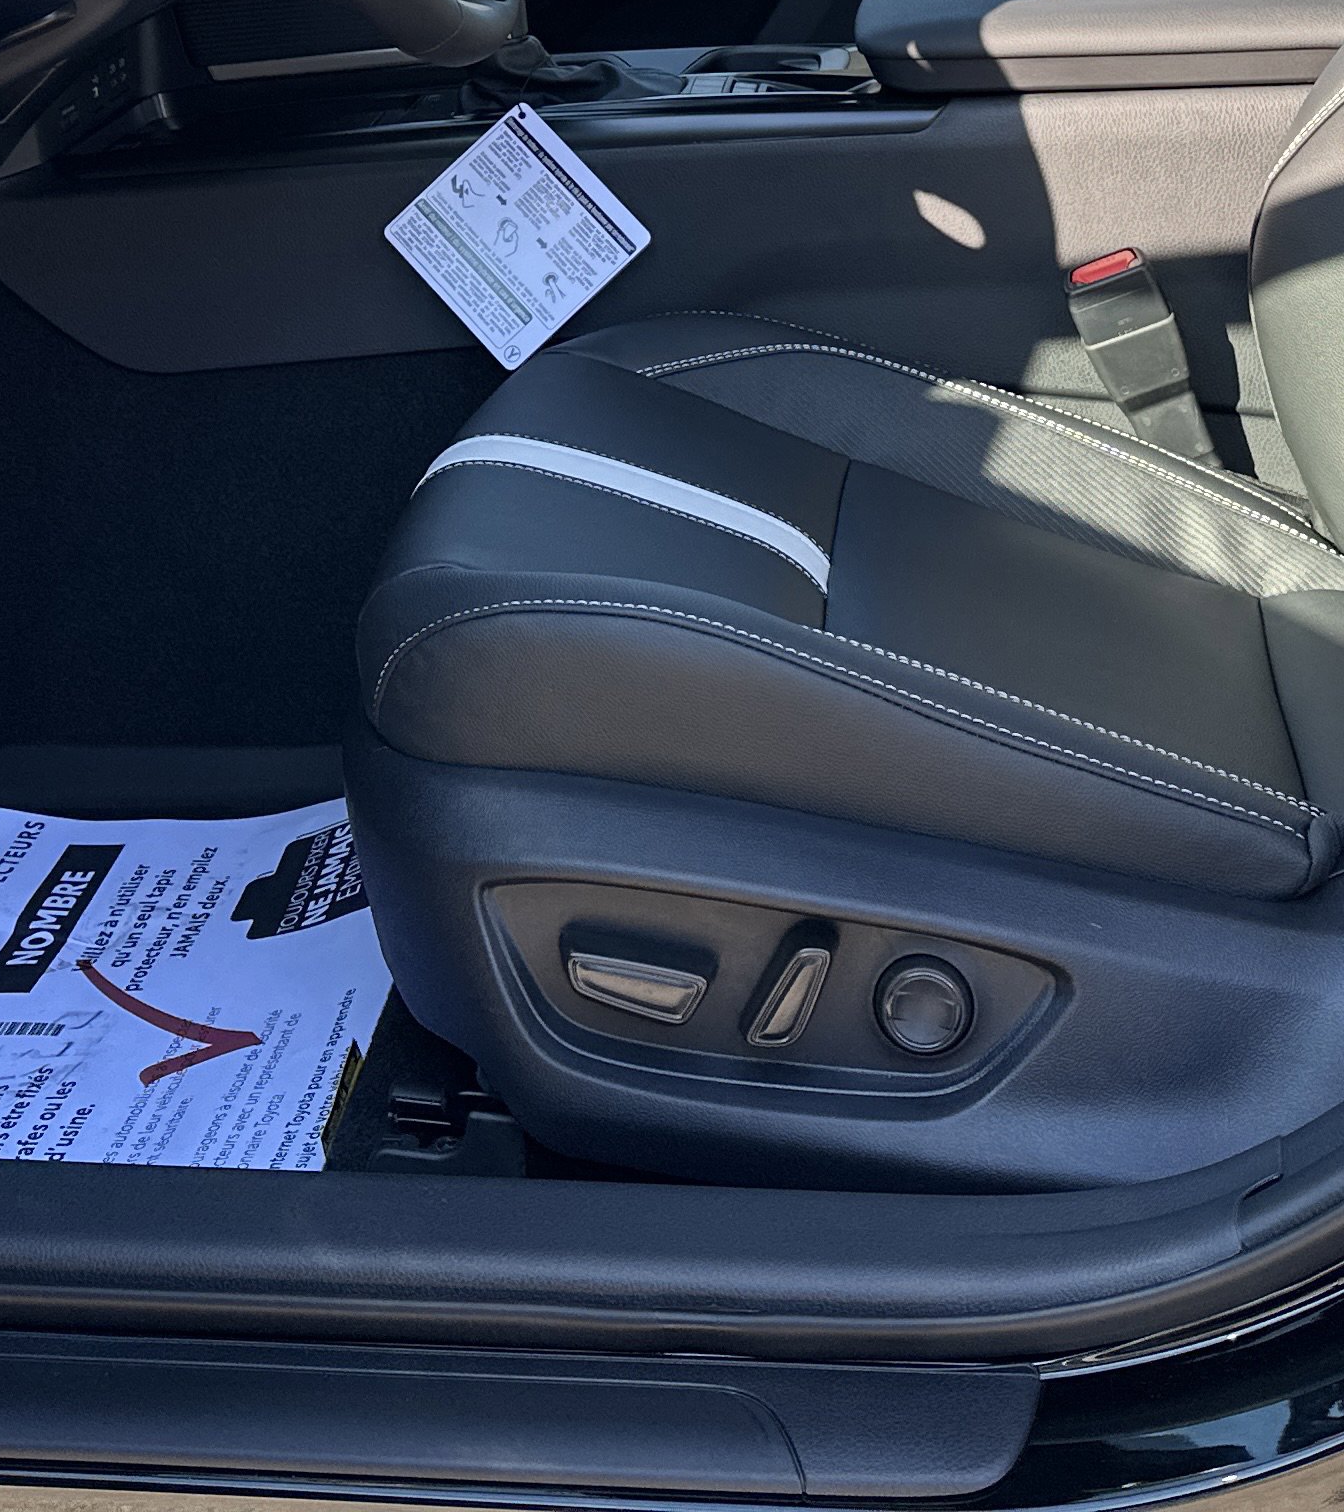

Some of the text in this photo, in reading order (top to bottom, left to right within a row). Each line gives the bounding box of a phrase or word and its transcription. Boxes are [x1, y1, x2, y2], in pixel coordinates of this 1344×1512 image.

[108, 861, 151, 915] n'utiliser
[276, 829, 332, 933] TOUJOURS FIXER
[301, 825, 353, 926] NE JAMAIS
[4, 869, 96, 965] NOMBRE
[98, 917, 119, 927] à
[109, 867, 177, 966] qu'un seul tapis
[124, 846, 218, 990] protecteur, n'en empilez
[169, 874, 231, 957] JAMAIS deux.
[326, 988, 357, 1046] apprendre
[222, 1065, 254, 1101] discuter
[243, 1049, 263, 1060] de
[232, 1105, 255, 1130] avec
[245, 1092, 261, 1104] un
[254, 1030, 294, 1090] représentant
[283, 1011, 302, 1025] de
[319, 1048, 334, 1061] en
[14, 1064, 55, 1099] fixés
[45, 1079, 77, 1101] les
[307, 1065, 327, 1090] pour
[39, 1102, 63, 1120] ou
[109, 1073, 162, 1146] automobilist
[138, 1113, 163, 1132] leur
[284, 1092, 316, 1127] Toyota
[305, 1124, 324, 1138] de
[131, 1138, 150, 1151] de
[294, 1141, 318, 1167] sujet
